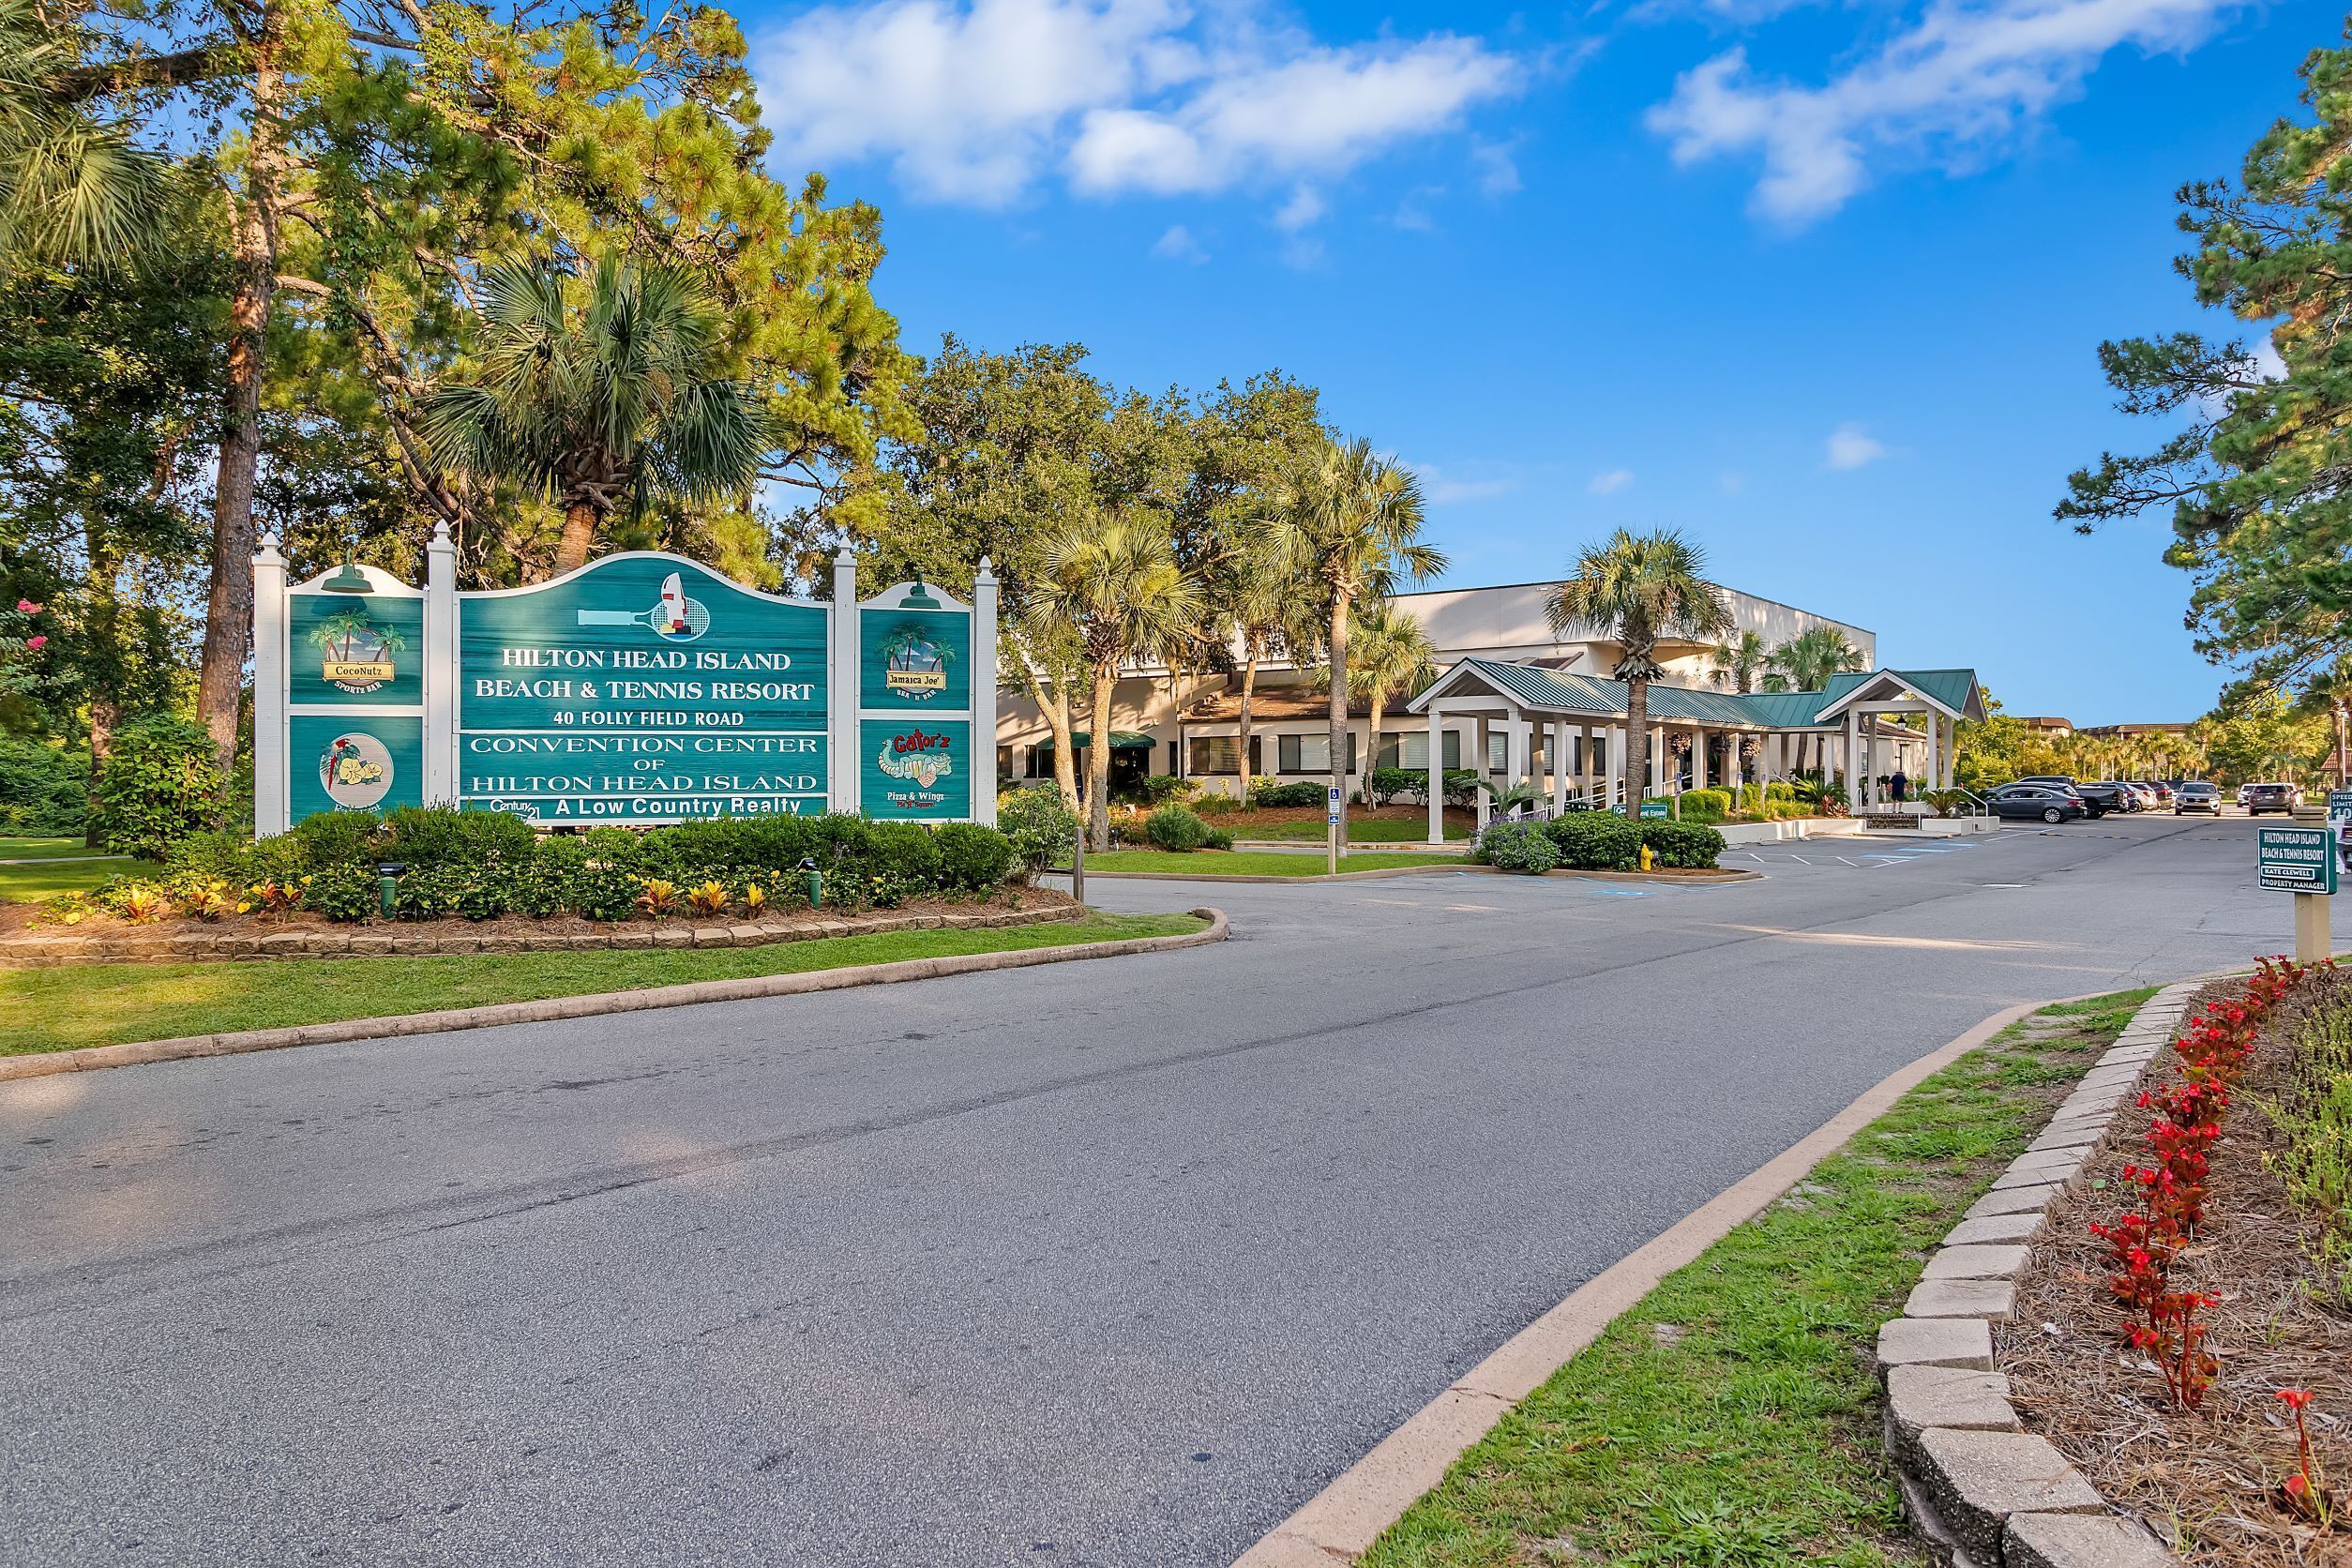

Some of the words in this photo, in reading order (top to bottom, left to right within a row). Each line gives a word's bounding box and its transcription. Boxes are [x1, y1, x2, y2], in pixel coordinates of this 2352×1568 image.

[502, 648, 605, 668] HILTON
[611, 650, 687, 669] HEAD
[695, 652, 792, 671] ISLAND
[335, 666, 383, 676] CocoNutz
[367, 681, 383, 692] BAR
[889, 675, 922, 685] Jamaica
[475, 679, 572, 698] BEACH
[580, 681, 599, 699] &
[605, 681, 702, 700] TENNIS
[711, 682, 815, 701] RESORT
[922, 689, 937, 701] BAR
[553, 711, 574, 725] 40
[581, 711, 634, 725] FOLLY
[641, 711, 687, 725] FIELD
[695, 712, 744, 726] ROAD
[470, 737, 685, 753] CONVENTION
[694, 737, 818, 753] CENTER
[894, 729, 951, 753] Gator'z
[633, 759, 666, 771] OF
[472, 776, 593, 792] HILTON
[603, 776, 694, 791] HEAD
[704, 776, 817, 791] ISLAND
[887, 792, 907, 801] Pizza
[909, 792, 915, 801] &
[918, 792, 944, 803] Wingz
[490, 799, 533, 814] Century
[527, 807, 541, 820] 21
[554, 799, 571, 815] A
[579, 799, 624, 815] Low
[632, 797, 723, 817] Country
[731, 797, 801, 815] Realty
[2264, 832, 2284, 843] HILTON
[2284, 833, 2299, 844] HEAD
[2300, 834, 2321, 845] ISLAND
[2261, 847, 2278, 858] BEACH
[2279, 849, 2284, 858] &
[2284, 848, 2303, 860] TENNIS
[2303, 849, 2324, 861] RESORT
[2261, 879, 2292, 888] PROPERTY
[2293, 881, 2325, 890] MANAGER
